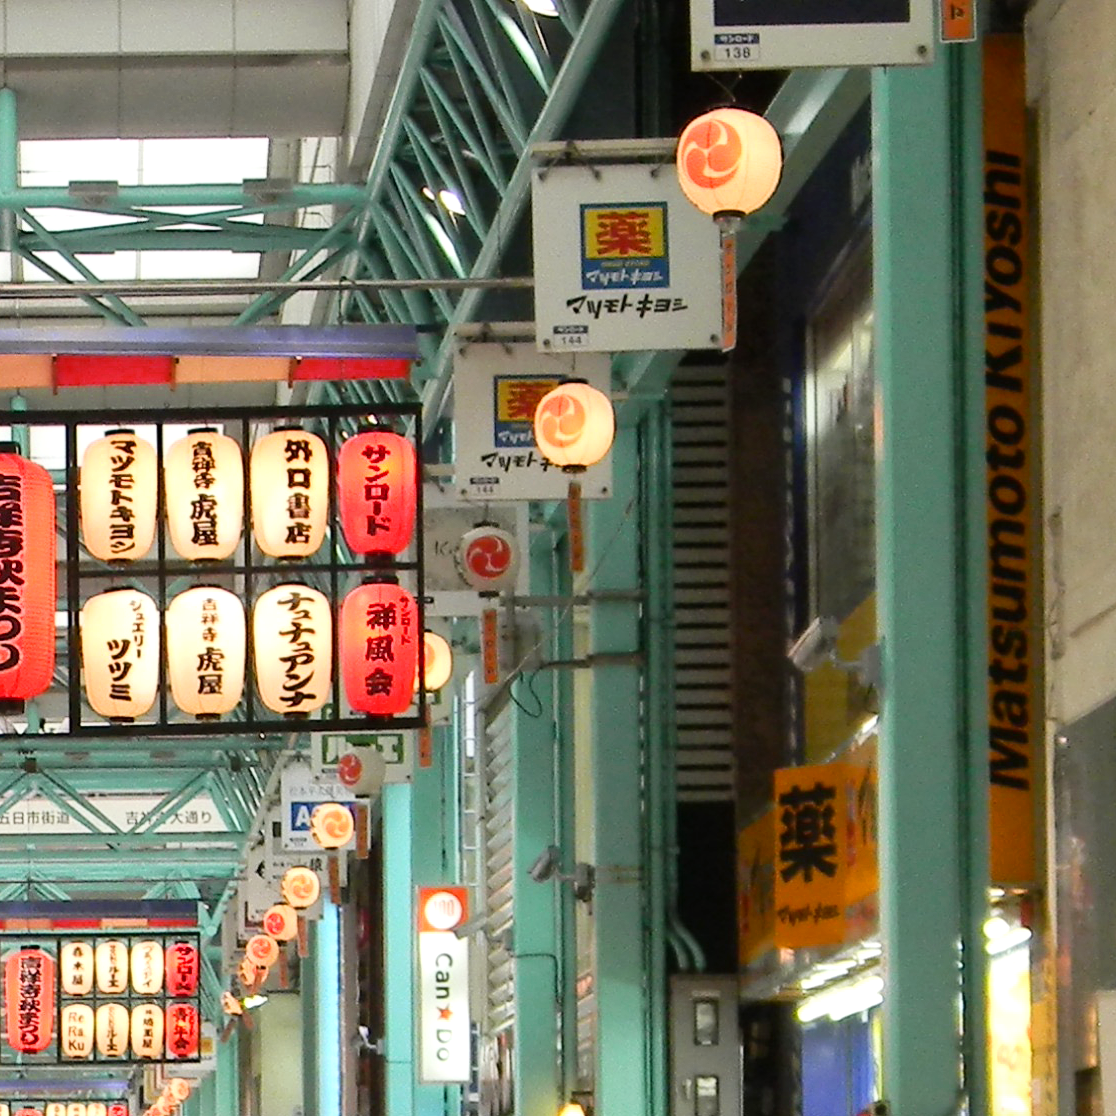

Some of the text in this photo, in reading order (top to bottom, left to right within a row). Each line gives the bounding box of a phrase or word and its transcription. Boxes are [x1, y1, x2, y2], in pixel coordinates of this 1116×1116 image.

[724, 47, 751, 59] 138
[595, 211, 652, 256] 薬
[586, 269, 663, 286] マツモトキヨシ
[566, 293, 689, 319] マツモトキヨシ
[561, 337, 582, 345] 144
[110, 440, 137, 555] マツモトキヨシ
[190, 441, 219, 547] 吉祥寺 虎屋
[284, 439, 313, 545] 外口書店
[362, 444, 391, 537] サンロード
[399, 596, 411, 646] サンロード
[987, 405, 1030, 790] Matsumoto
[129, 599, 145, 659] ジュエリー
[196, 597, 226, 695] 吉祥寺 虎屋
[106, 638, 133, 702] ツツミ
[68, 1012, 85, 1023] Re
[68, 1025, 85, 1037] Ra
[434, 952, 456, 1062] Can Do
[68, 1039, 85, 1051] Ku
